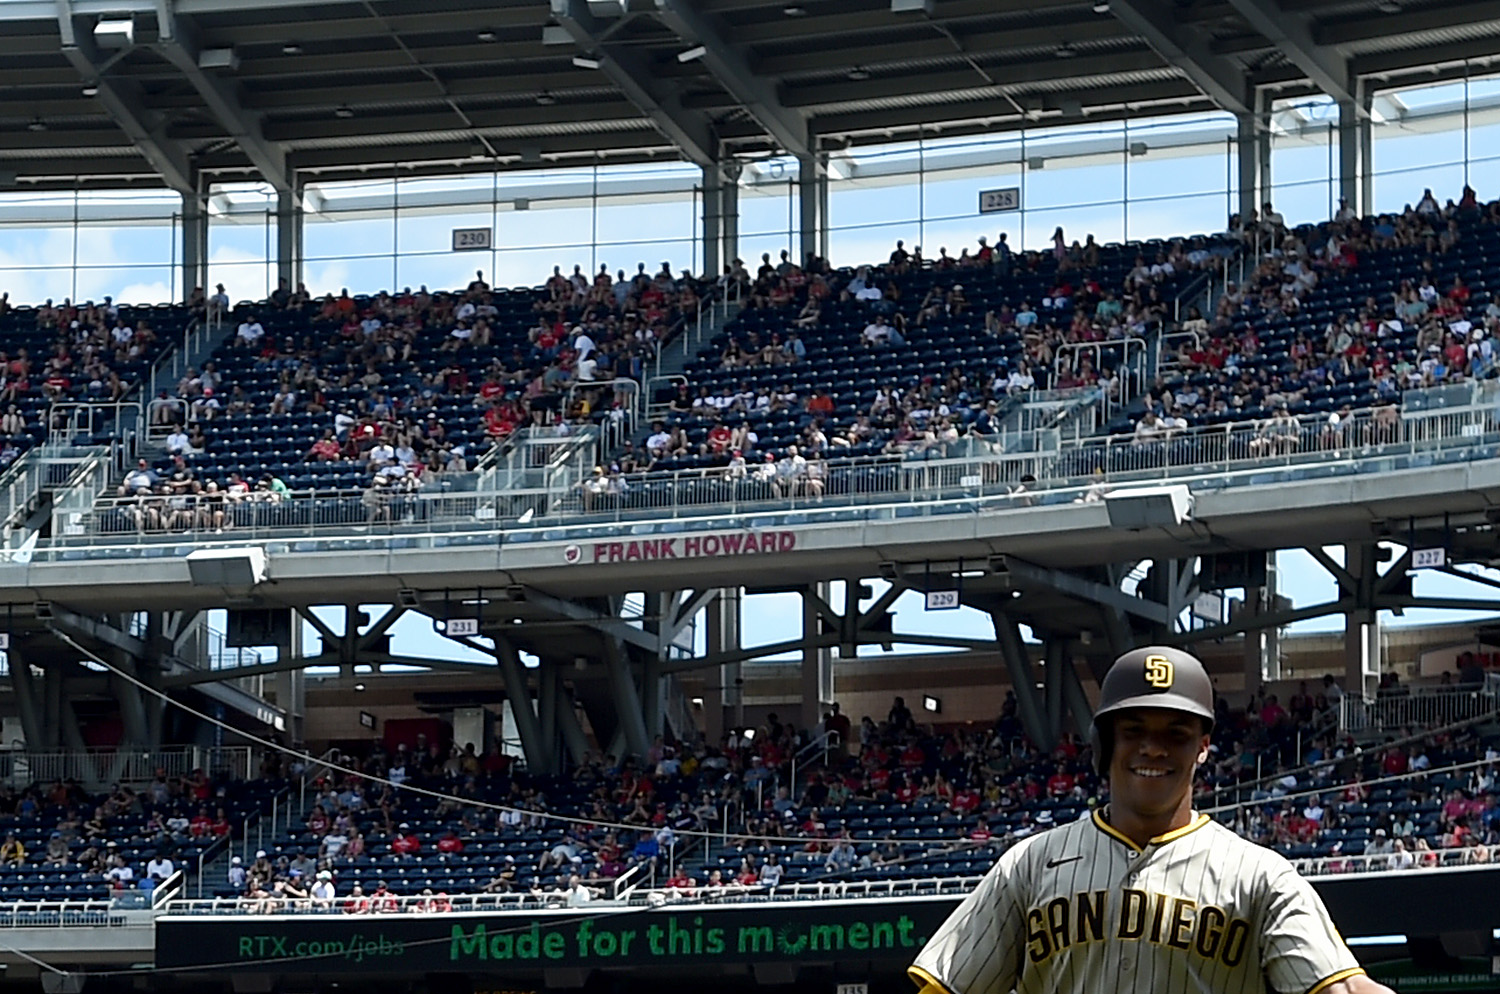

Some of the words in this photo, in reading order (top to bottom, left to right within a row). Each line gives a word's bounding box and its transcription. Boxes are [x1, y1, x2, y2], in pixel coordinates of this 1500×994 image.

[987, 193, 1012, 207] 228
[460, 232, 485, 245] 230
[593, 538, 678, 563] FRANK
[685, 531, 797, 555] HOWARD
[1418, 551, 1440, 565] 227
[932, 593, 954, 606] 229
[452, 621, 472, 632] 231
[1145, 654, 1174, 688] SD
[1027, 889, 1109, 964] SAN
[1117, 887, 1251, 968] DIEGO
[238, 934, 404, 962] RTX.com/jobs
[450, 920, 566, 961] Made
[576, 919, 637, 957] for
[646, 917, 726, 955] this
[737, 914, 927, 955] moment.
